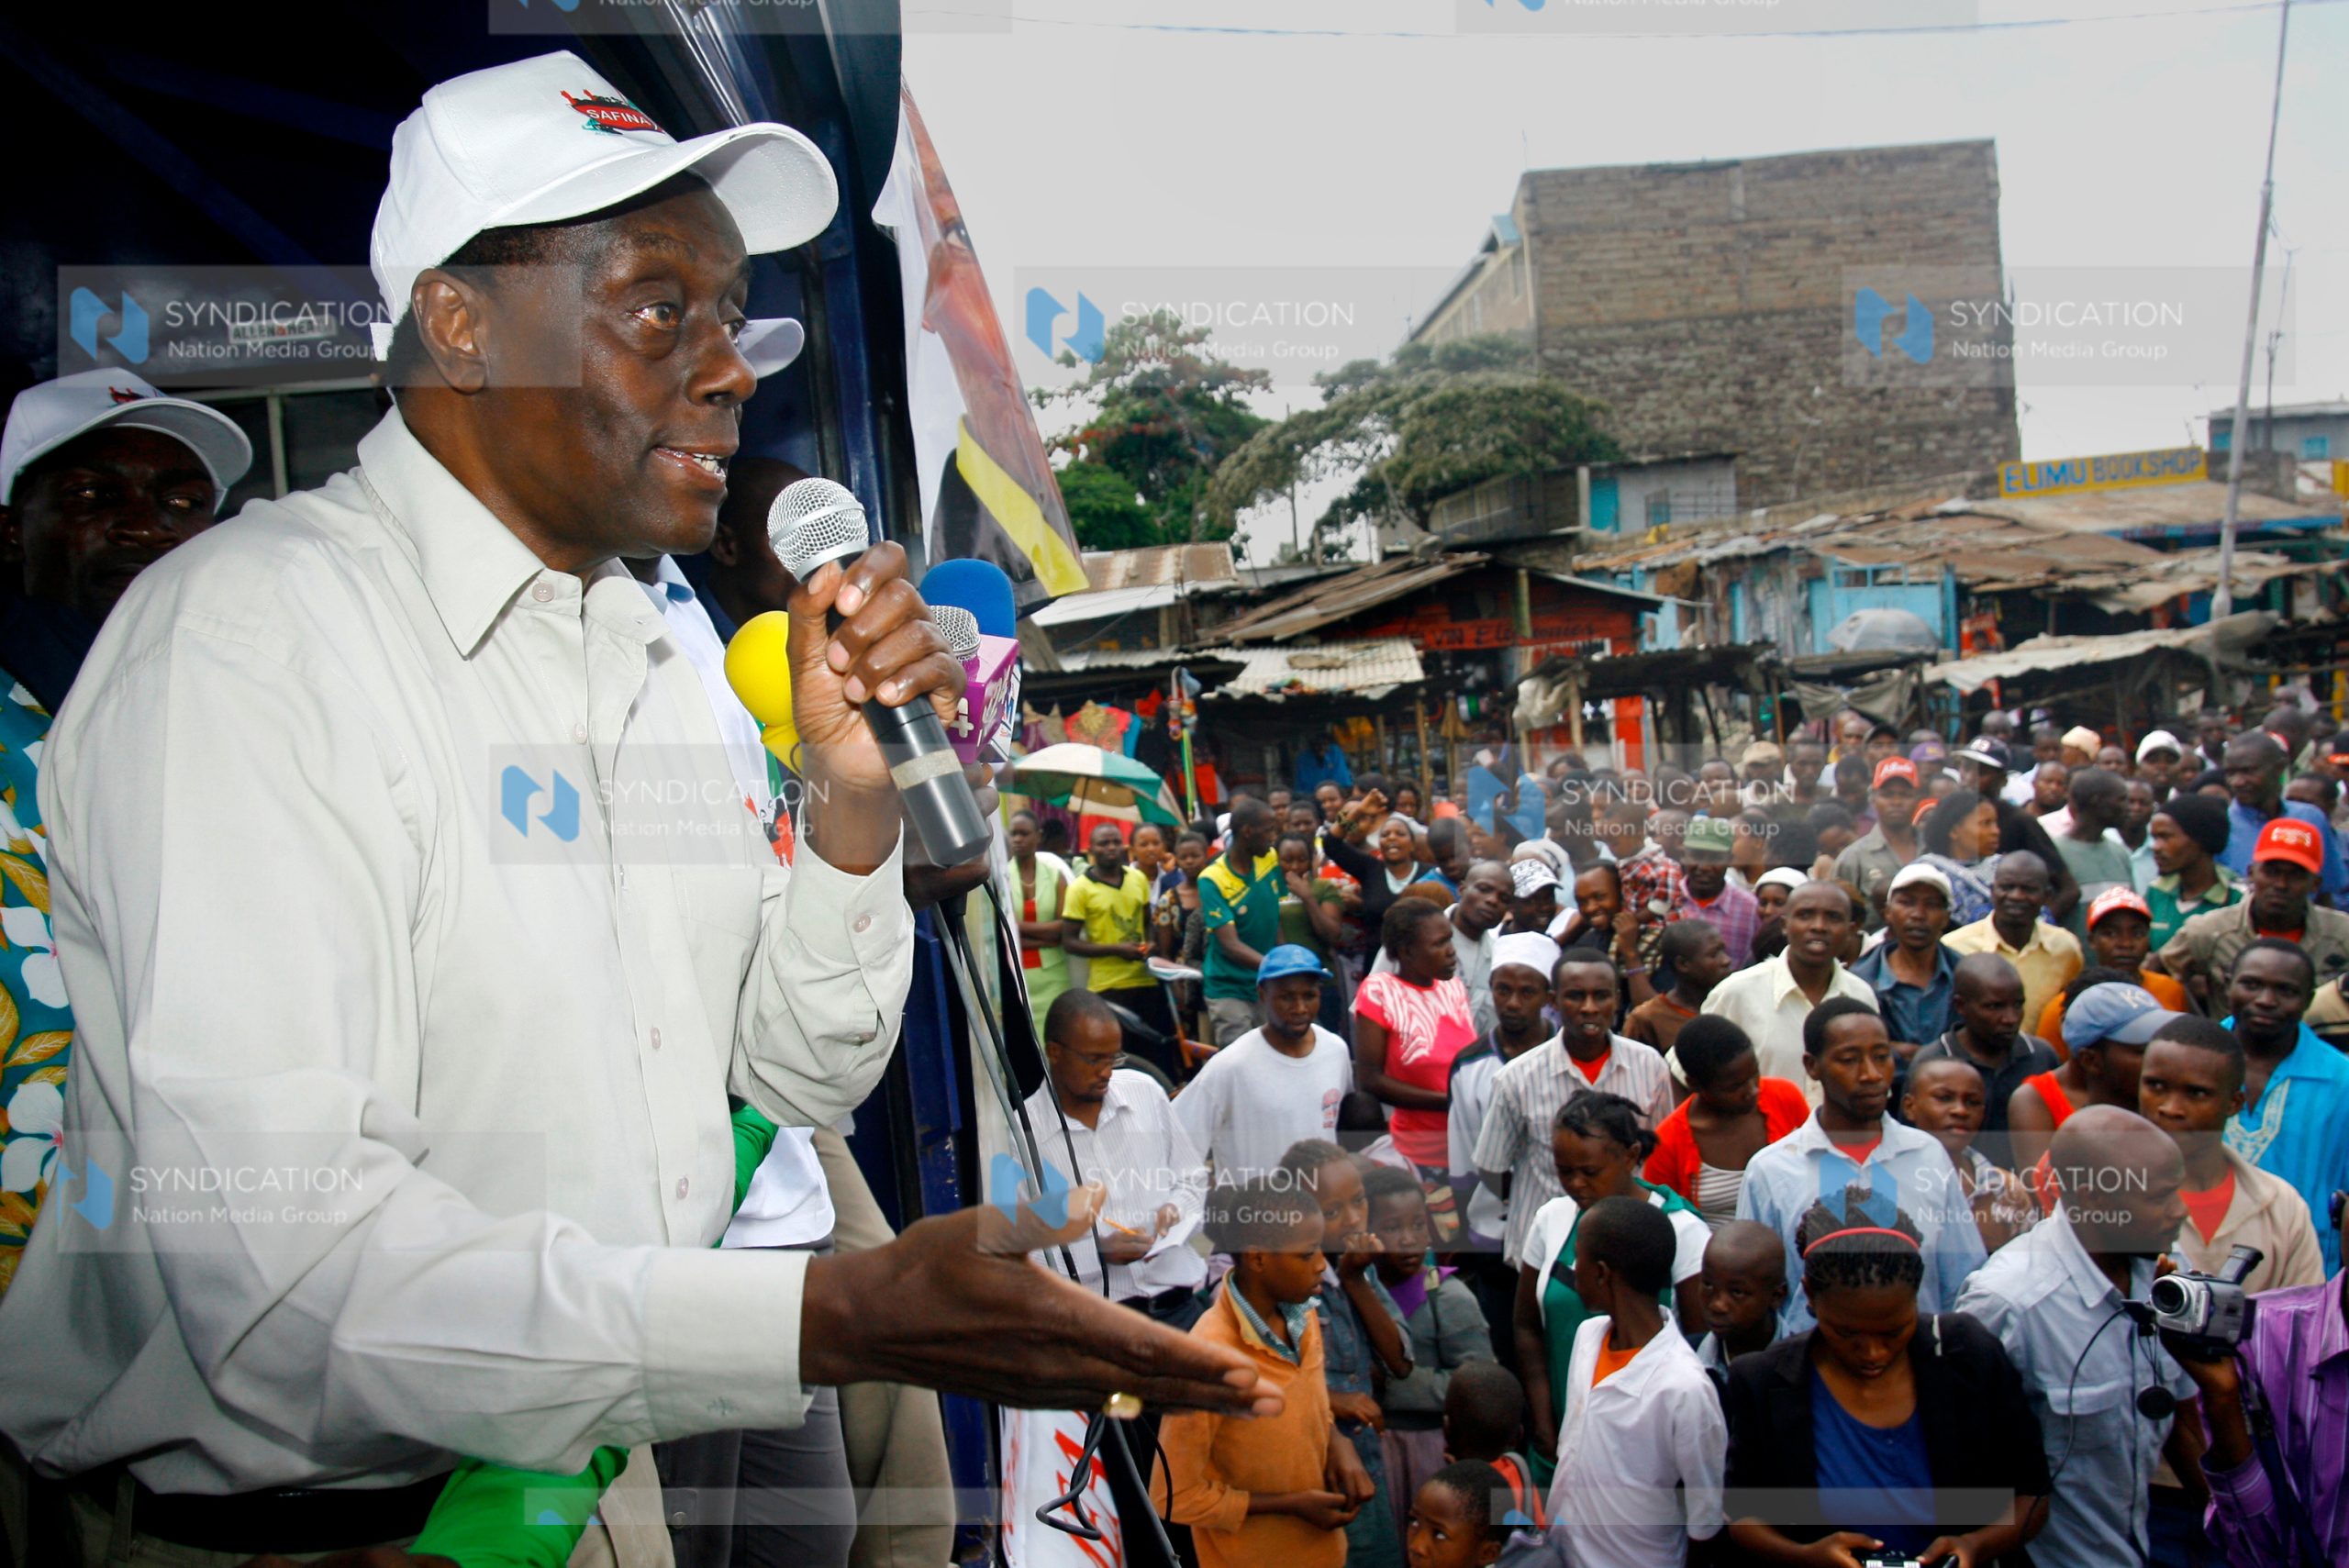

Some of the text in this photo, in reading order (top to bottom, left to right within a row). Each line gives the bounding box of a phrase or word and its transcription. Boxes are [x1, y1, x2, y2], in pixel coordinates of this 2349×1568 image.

[586, 108, 651, 126] SAFINA
[2004, 448, 2201, 493] ELIMU BOOKSHOP
